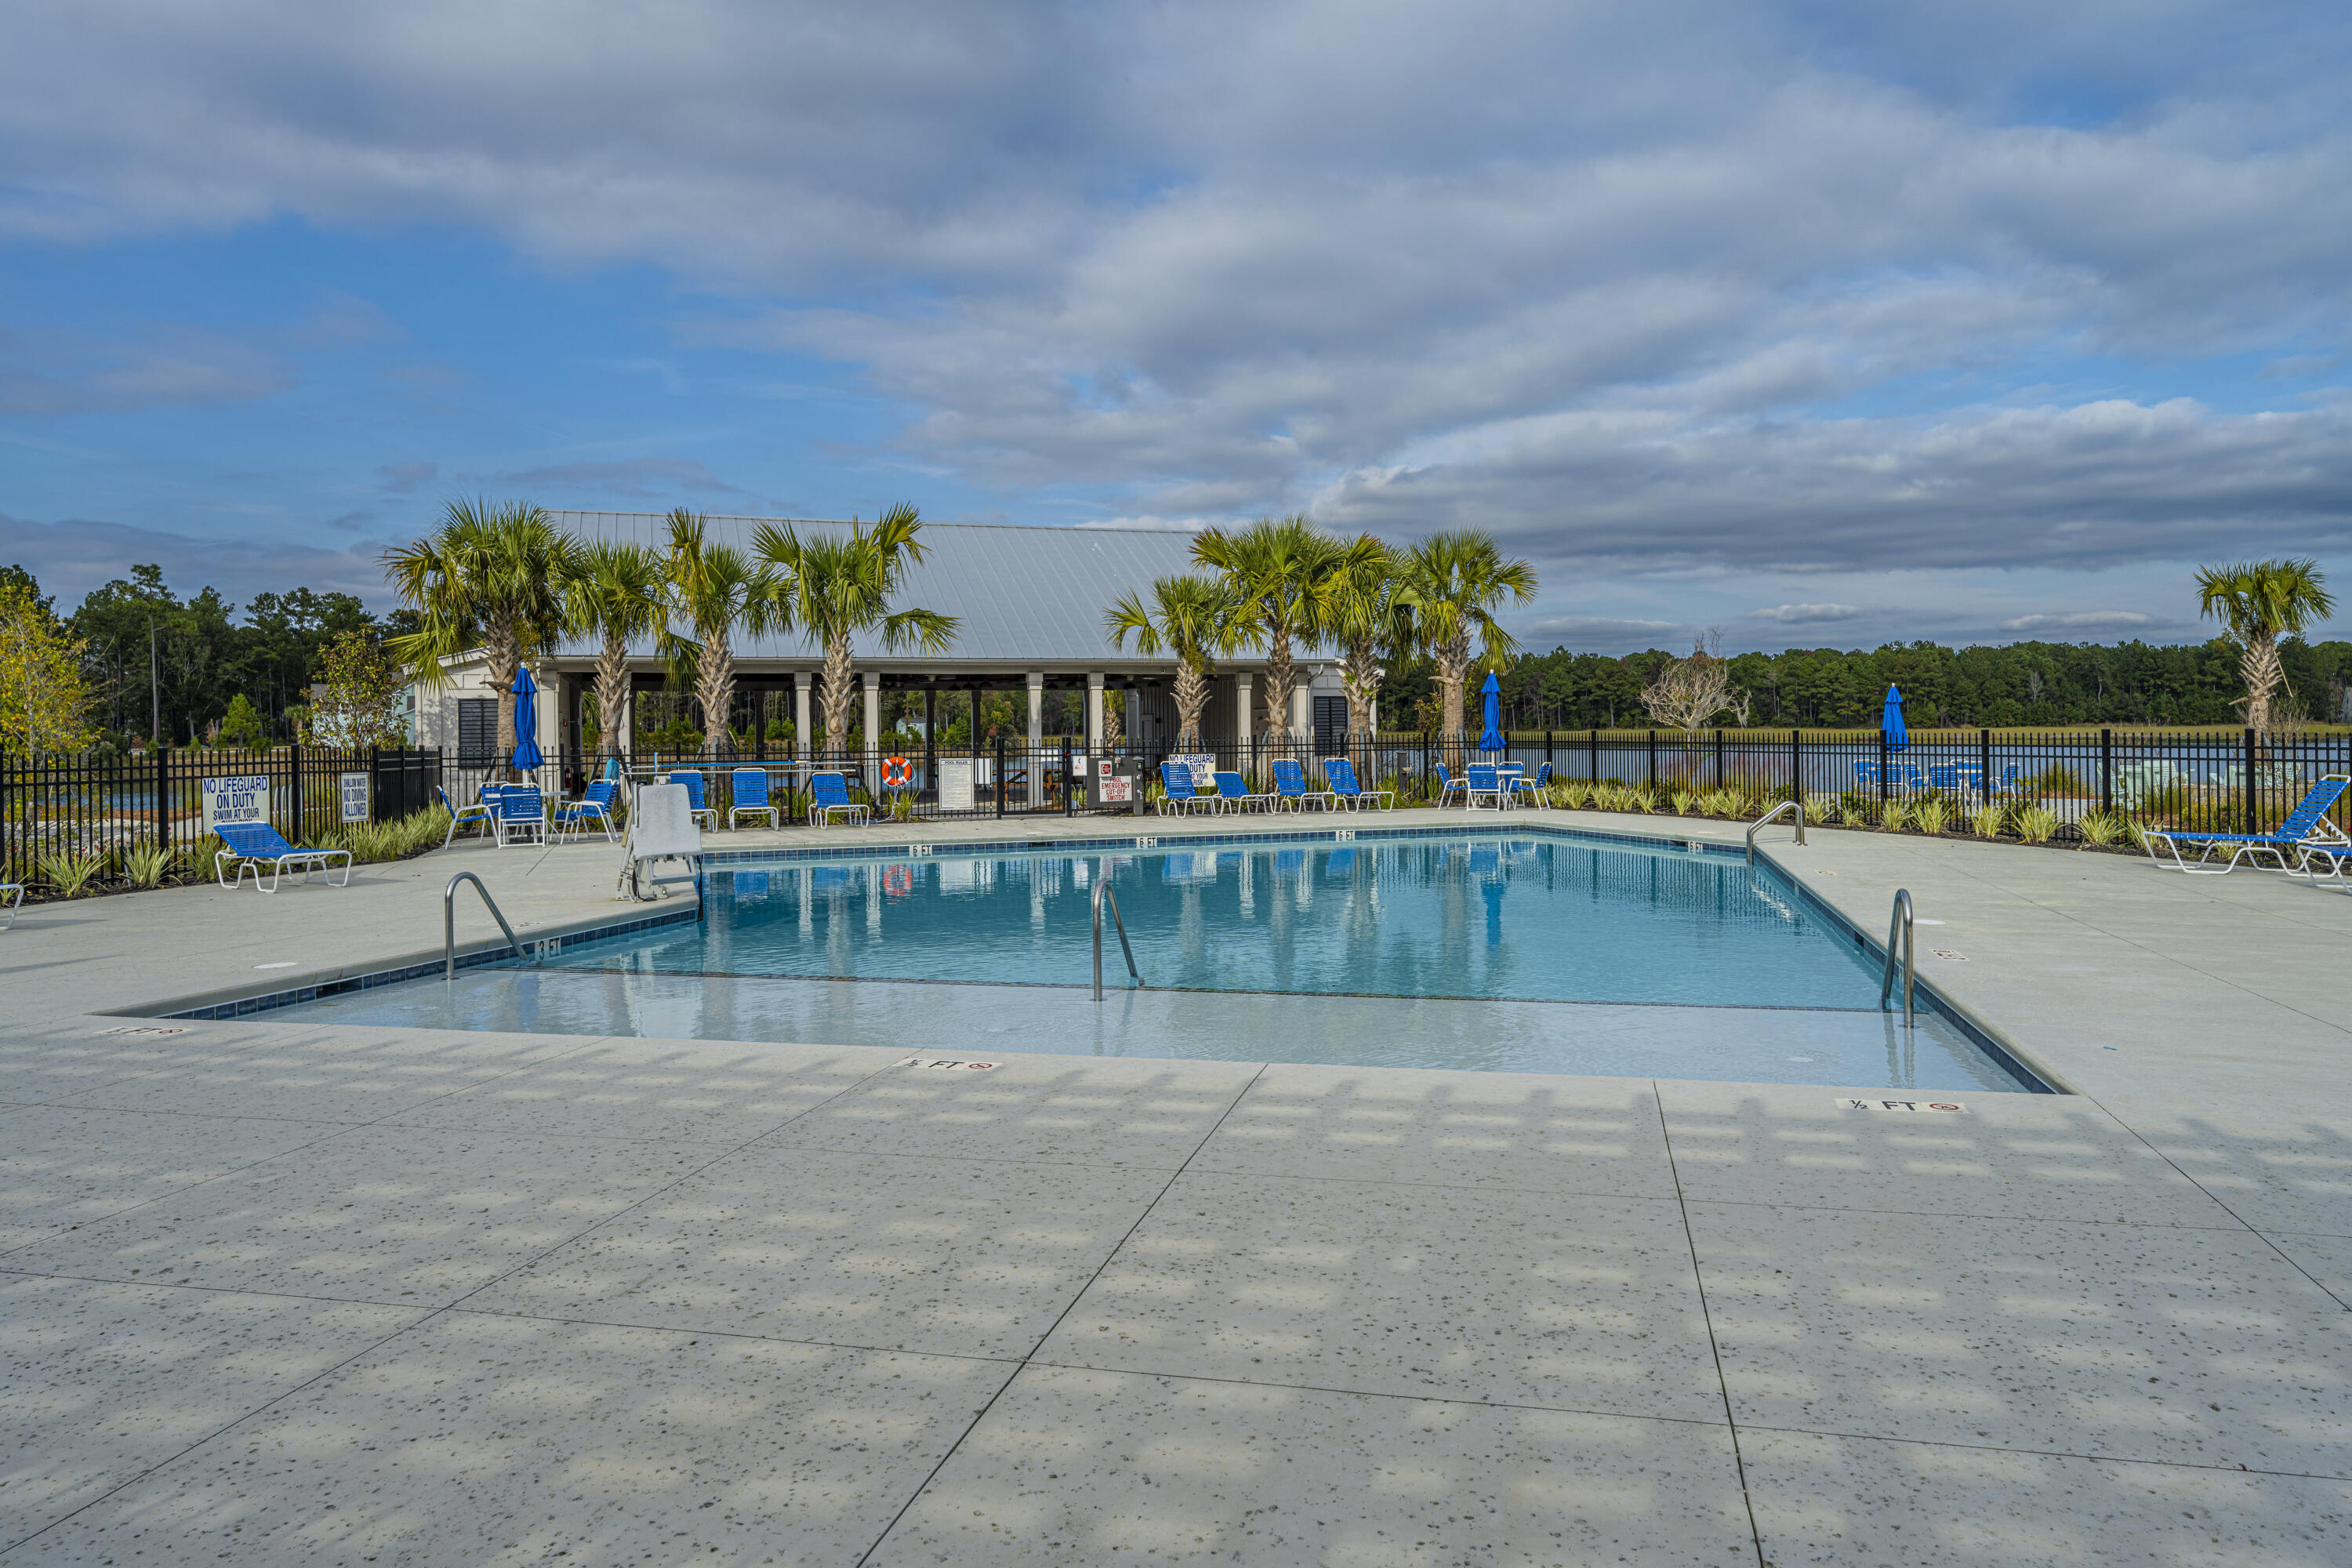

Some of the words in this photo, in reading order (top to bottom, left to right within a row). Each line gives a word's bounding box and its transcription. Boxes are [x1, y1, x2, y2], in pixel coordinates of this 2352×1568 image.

[1180, 754, 1215, 764] LIFEGUARD
[1189, 764, 1206, 773] DUTY
[203, 779, 216, 794] NO
[219, 776, 268, 793] LIFEGUARD
[343, 789, 350, 802] NO
[351, 788, 367, 802] DIVING
[216, 793, 230, 809] ON
[232, 793, 256, 808] DUTY
[213, 809, 232, 821] SWIM
[234, 808, 241, 819] AT
[242, 808, 260, 818] YOUR
[345, 802, 366, 817] ALLOWED
[1345, 830, 1354, 840] FT
[1147, 837, 1156, 848] FT
[1695, 842, 1702, 853] FT
[921, 844, 931, 856] FT
[549, 937, 560, 958] FT
[927, 1060, 965, 1069] FT
[1882, 1101, 1916, 1111] FT
